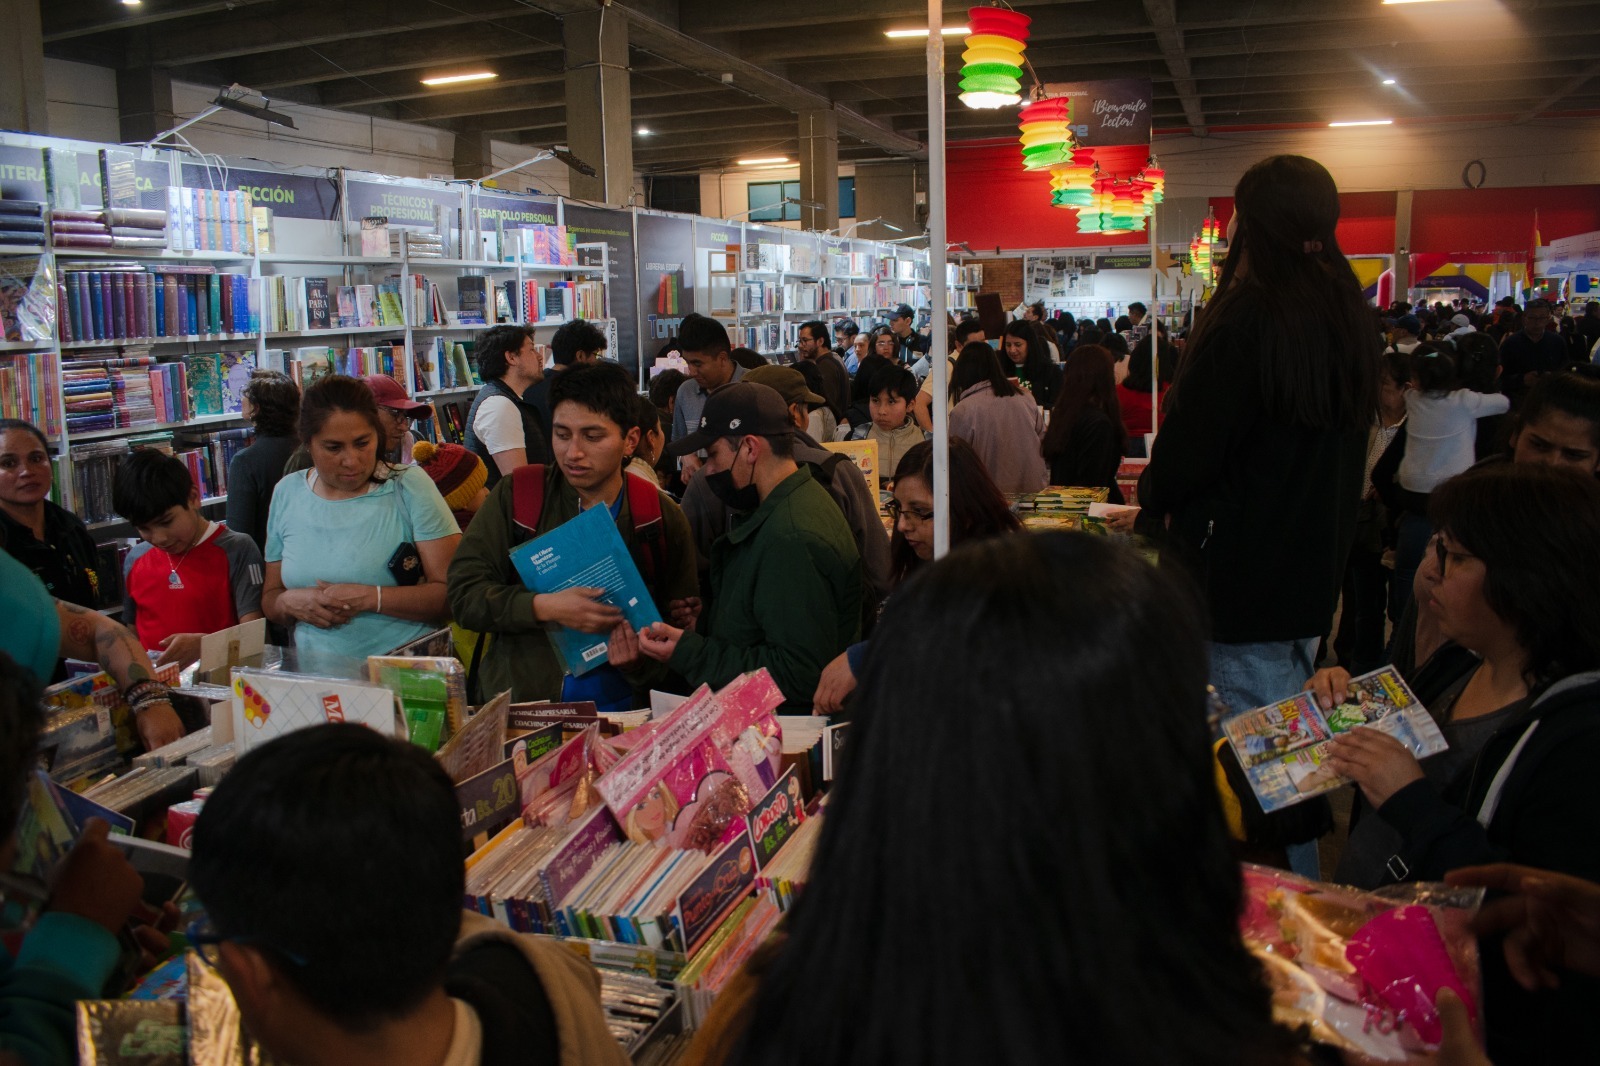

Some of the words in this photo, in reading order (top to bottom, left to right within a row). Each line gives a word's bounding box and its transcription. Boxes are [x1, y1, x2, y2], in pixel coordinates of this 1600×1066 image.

[1092, 98, 1147, 115] ¡Bienvenido
[1101, 113, 1136, 128] Lector!
[381, 192, 427, 209] TÉCNICOS
[427, 198, 434, 209] Y
[521, 211, 556, 224] PERSONAL
[647, 314, 685, 340] Torr
[535, 708, 578, 716] EMPRESARIAL
[514, 719, 547, 728] COACHING
[493, 772, 516, 808] 20
